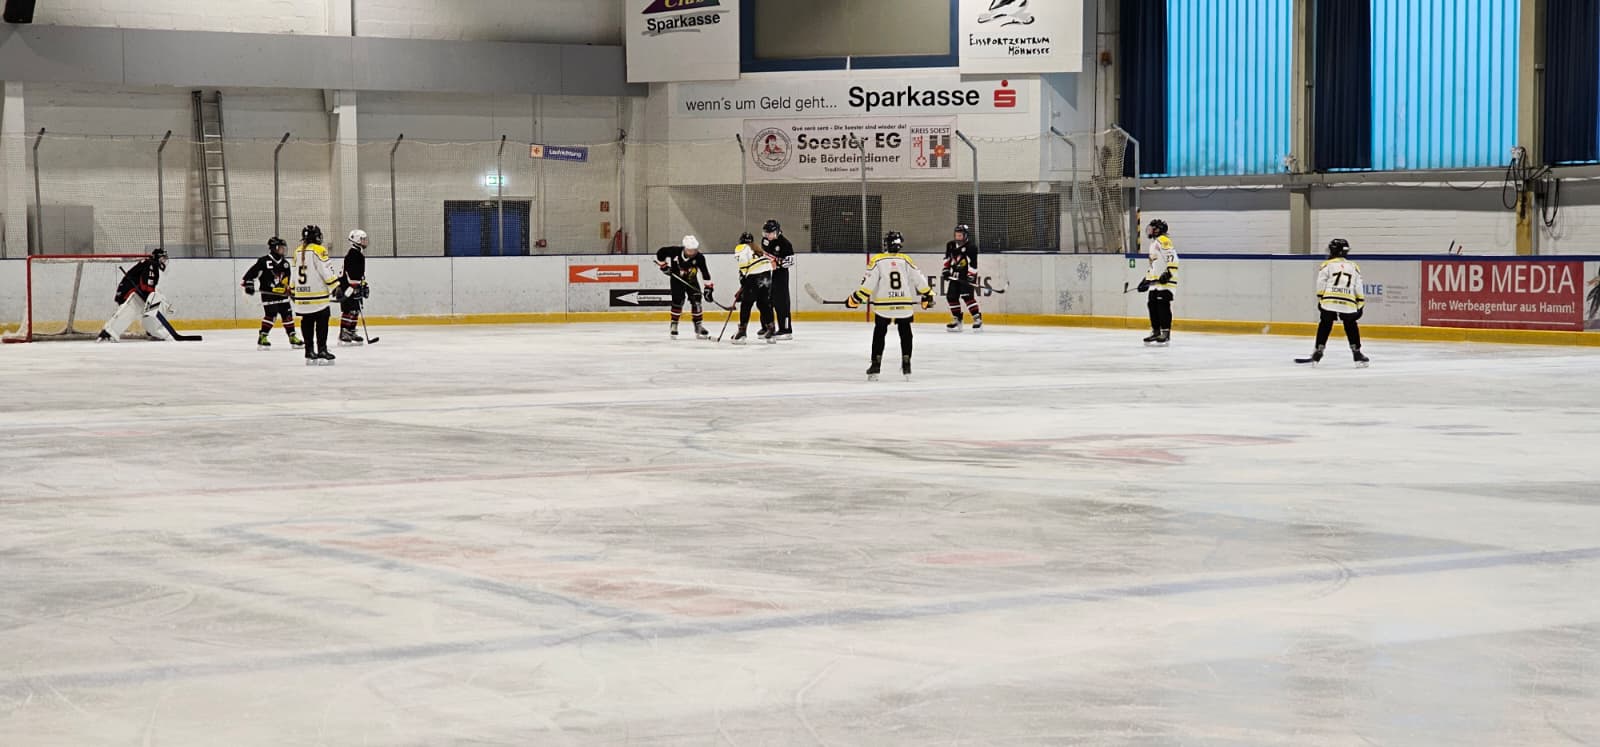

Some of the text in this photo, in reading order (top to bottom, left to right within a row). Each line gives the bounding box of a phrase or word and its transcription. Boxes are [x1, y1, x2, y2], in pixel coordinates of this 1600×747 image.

[647, 13, 721, 33] Sparkasse
[735, 100, 756, 110] um
[760, 96, 791, 109] Geld
[795, 96, 838, 112] geht...
[848, 85, 980, 112] Sparkasse
[875, 132, 902, 149] EG
[799, 154, 818, 164] Die
[266, 260, 274, 269] C
[298, 265, 308, 285] 5
[890, 271, 902, 290] 8
[1427, 264, 1576, 295] KMB MEDIA
[1428, 299, 1447, 311] Ihre
[1448, 300, 1517, 315] Werbeagentur
[1519, 305, 1537, 313] aus
[1539, 302, 1576, 314] Hamm!
